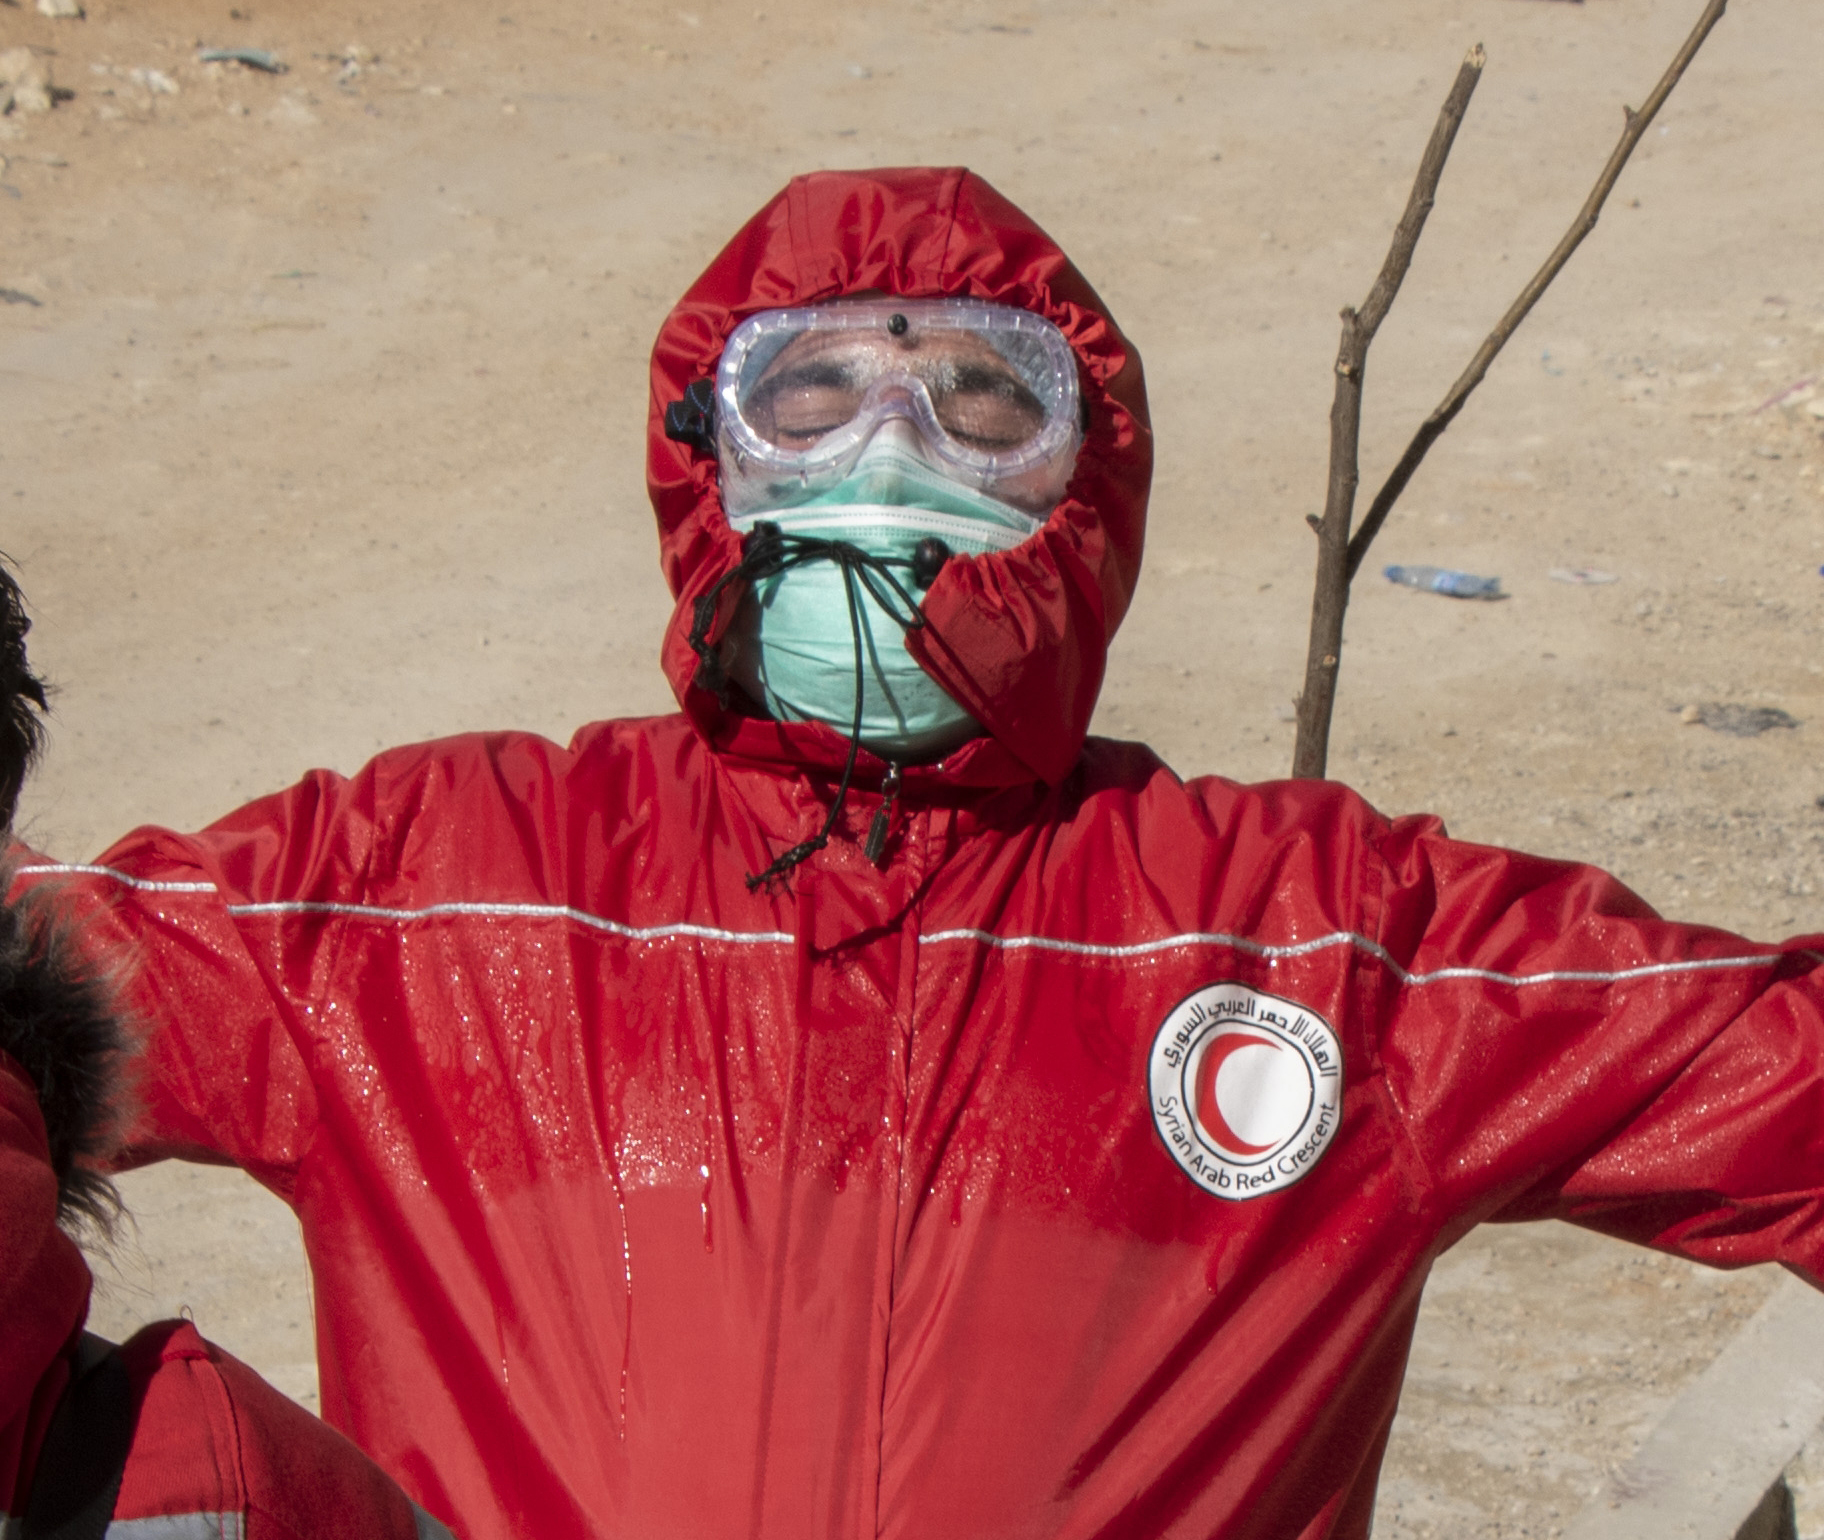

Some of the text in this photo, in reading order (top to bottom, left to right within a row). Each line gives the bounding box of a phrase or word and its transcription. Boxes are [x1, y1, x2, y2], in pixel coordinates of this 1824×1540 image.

[1164, 1002, 1207, 1068] السوري
[1208, 998, 1255, 1018] العربي
[1303, 1029, 1338, 1077] الهلال
[1157, 1096, 1334, 1190] Syrian Arab Red Crescent
